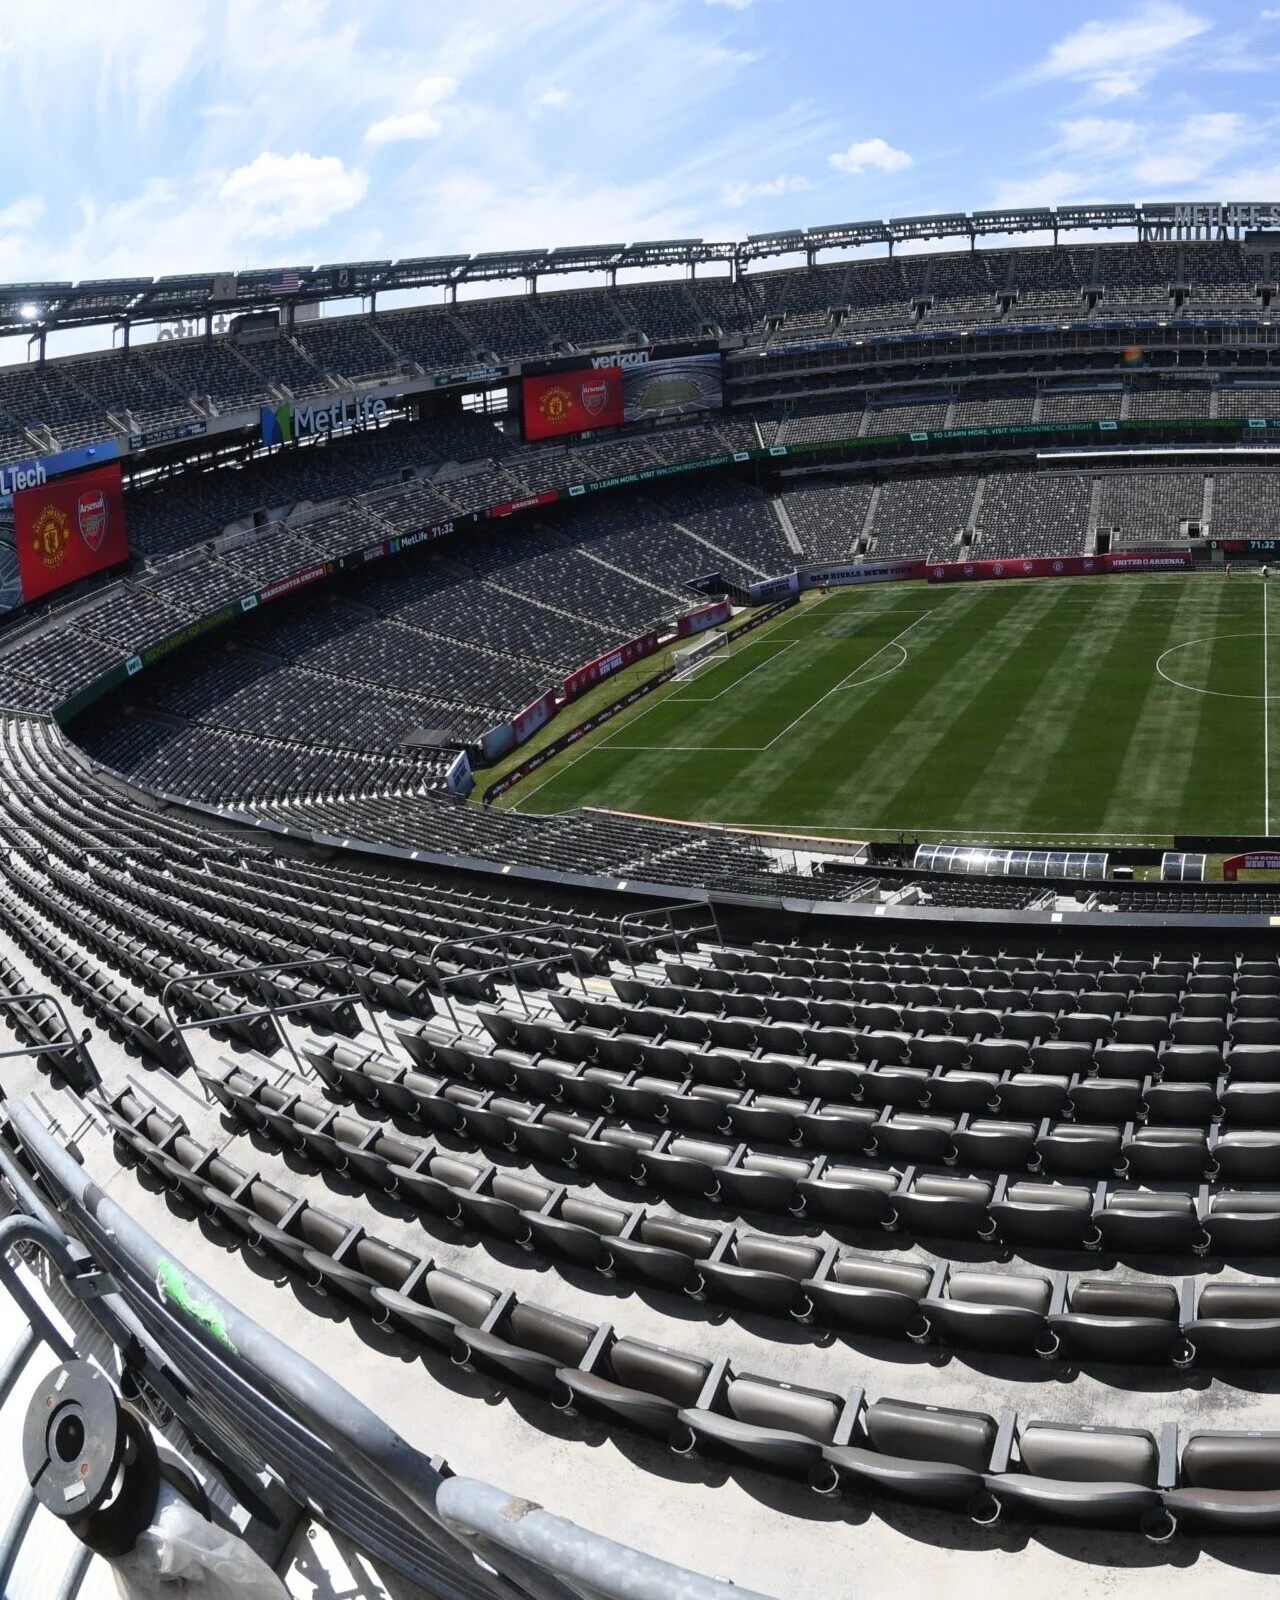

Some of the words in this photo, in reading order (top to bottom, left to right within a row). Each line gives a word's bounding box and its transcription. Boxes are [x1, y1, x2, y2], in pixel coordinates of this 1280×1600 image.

[1174, 205, 1263, 227] METLIFE
[591, 351, 650, 369] verizon
[294, 394, 387, 437] MetLife
[590, 483, 598, 491] TO
[600, 478, 619, 489] LEARN
[640, 471, 655, 480] VISIT
[80, 498, 104, 512] Arsenal
[401, 532, 428, 547] MetLife
[432, 523, 454, 538] 71:32
[810, 574, 829, 582] OLD
[863, 568, 889, 577] NEW
